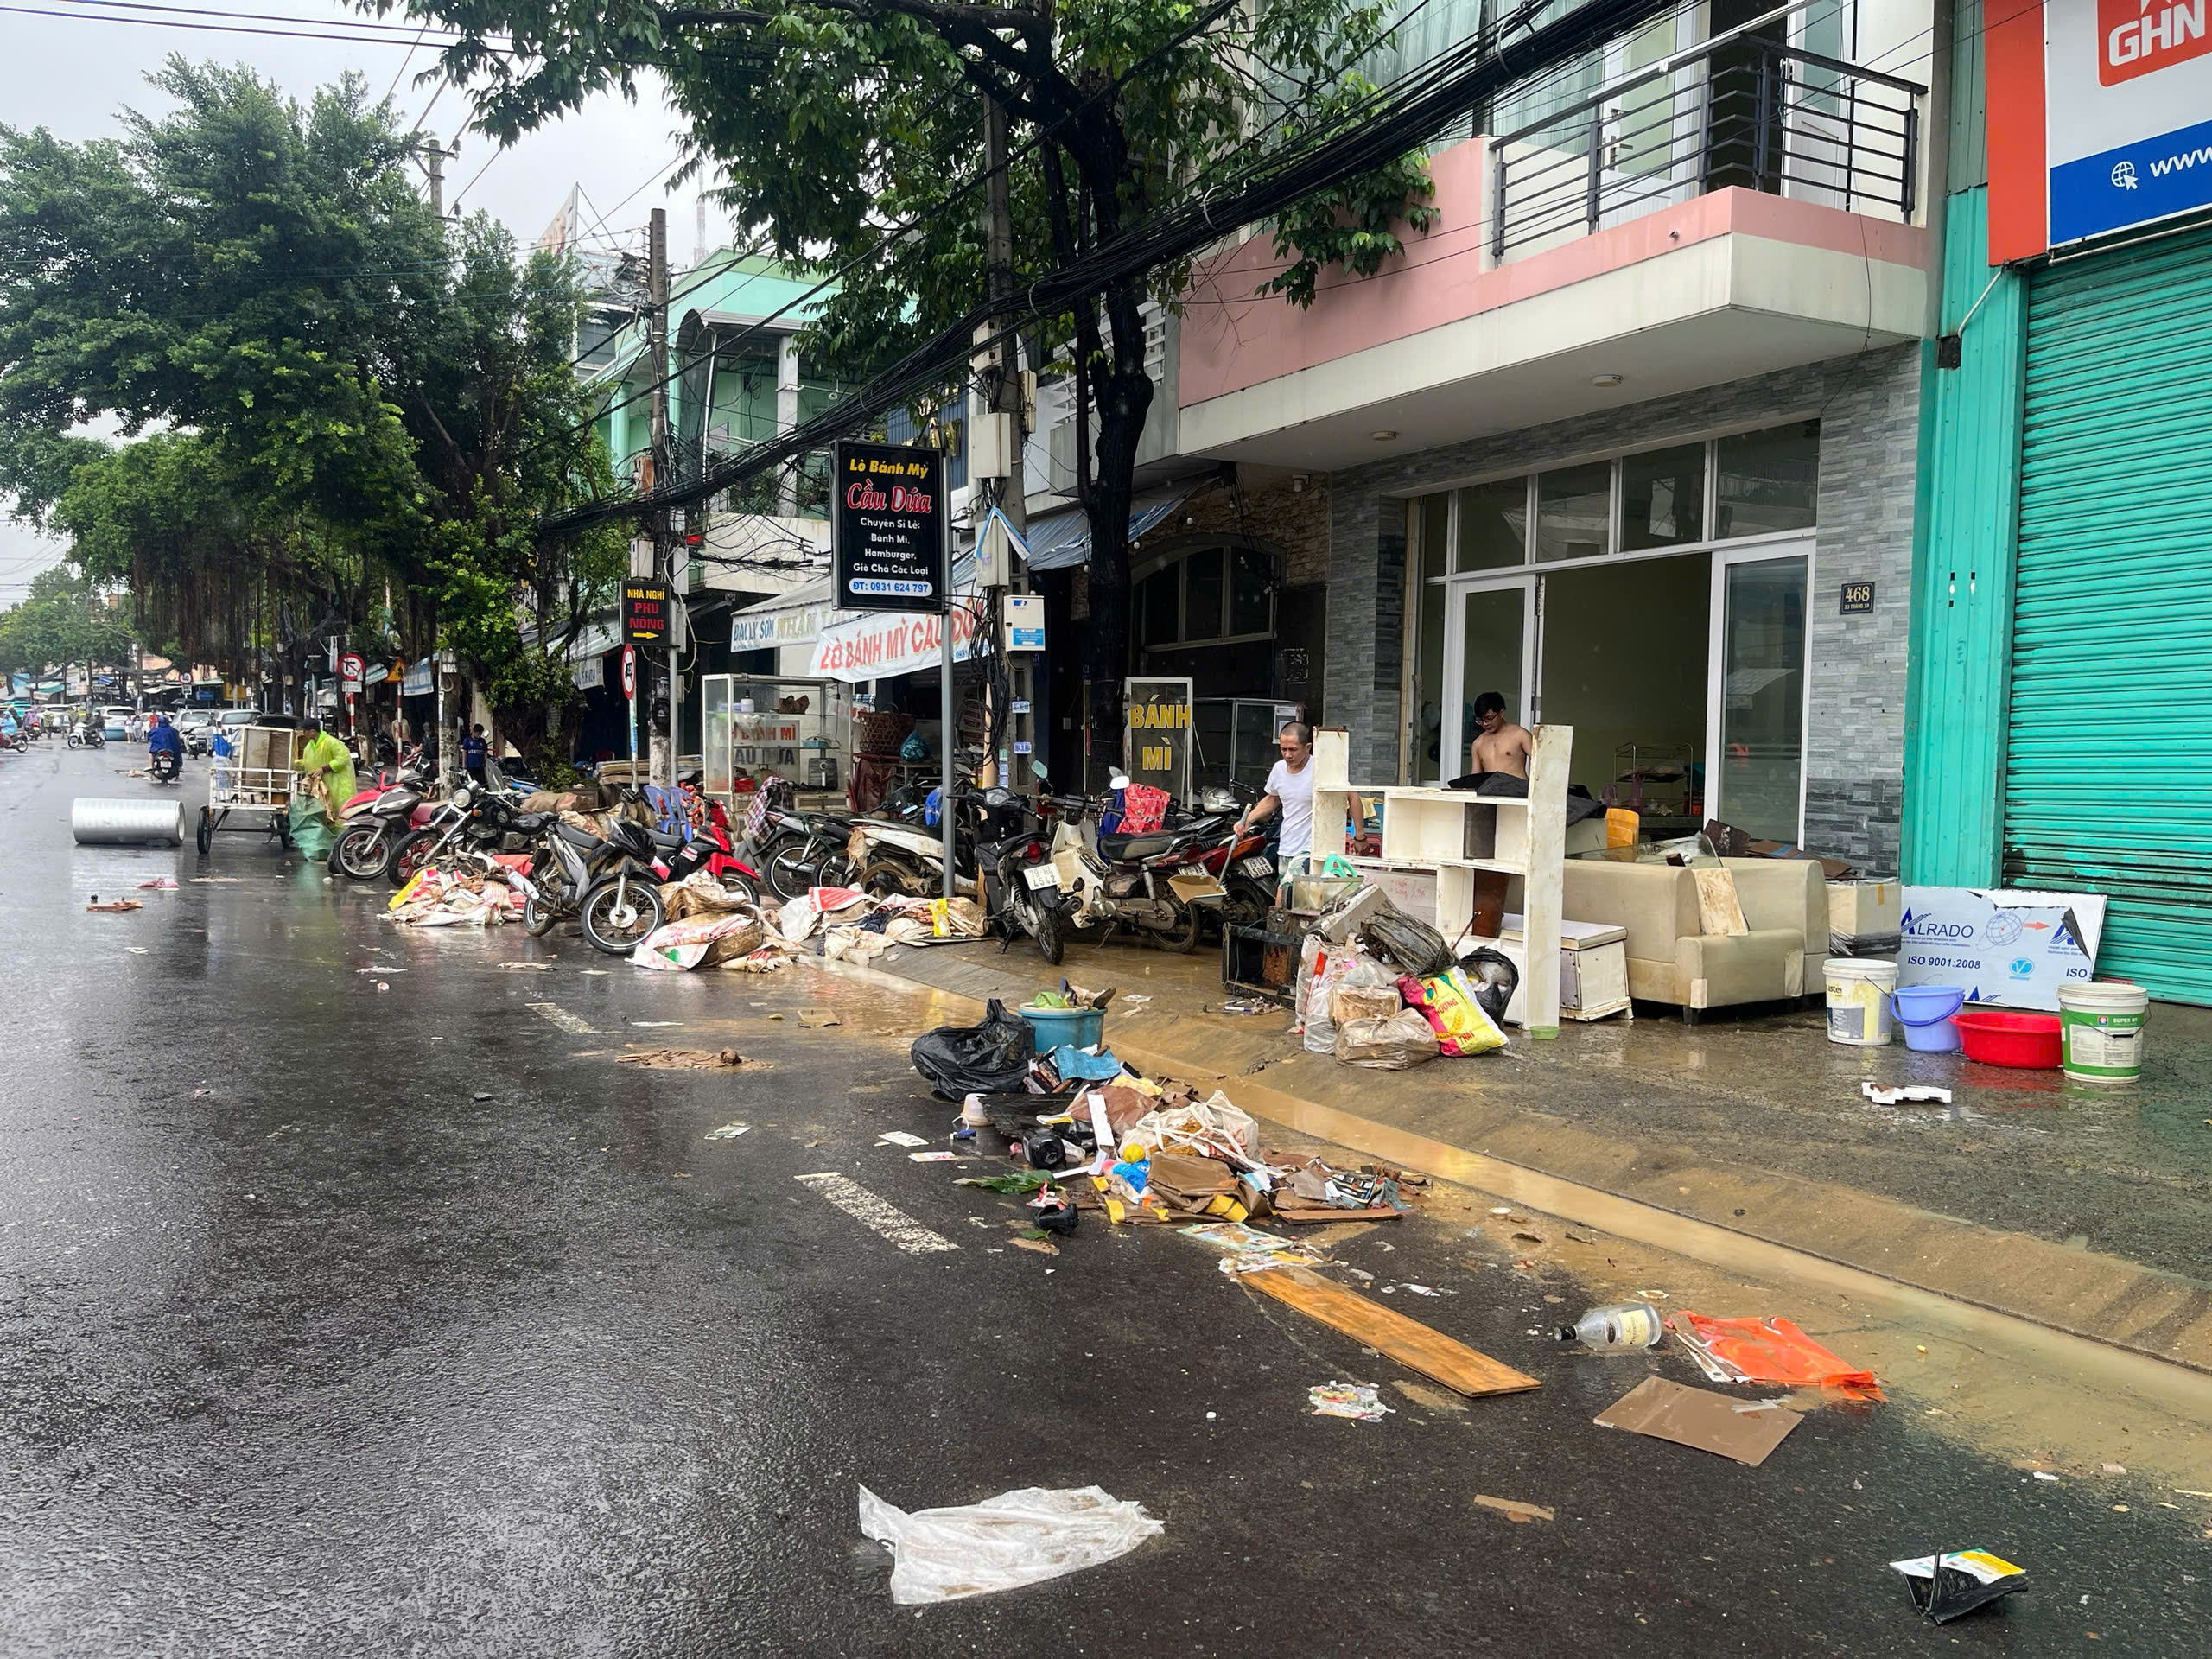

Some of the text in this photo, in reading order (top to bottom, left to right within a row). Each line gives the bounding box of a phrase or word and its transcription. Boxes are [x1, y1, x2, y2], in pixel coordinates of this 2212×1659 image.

[2108, 0, 2205, 67] GHN
[849, 458, 867, 472] Lò
[869, 460, 905, 474] Bánh
[847, 478, 932, 513] Cầu Dứa
[860, 517, 895, 530] Chuyên
[871, 532, 894, 543] Bánh
[864, 548, 917, 561] Hamburger,
[853, 563, 929, 576] Giò Chả Các Loại
[627, 588, 645, 599] NHÀ
[853, 582, 929, 593] ĐT: 0931 624 797
[1845, 586, 1870, 602] 468
[819, 636, 843, 670] LÒ
[845, 629, 882, 668] BÁNH
[886, 617, 908, 660] MỲ
[1130, 694, 1192, 728] BÁNH
[780, 723, 796, 741] MÌ
[1142, 736, 1172, 771] MÌ
[1033, 874, 1057, 887] 4542
[1908, 956, 1981, 969] ISO 9001:2008
[2066, 967, 2088, 978] ISO
